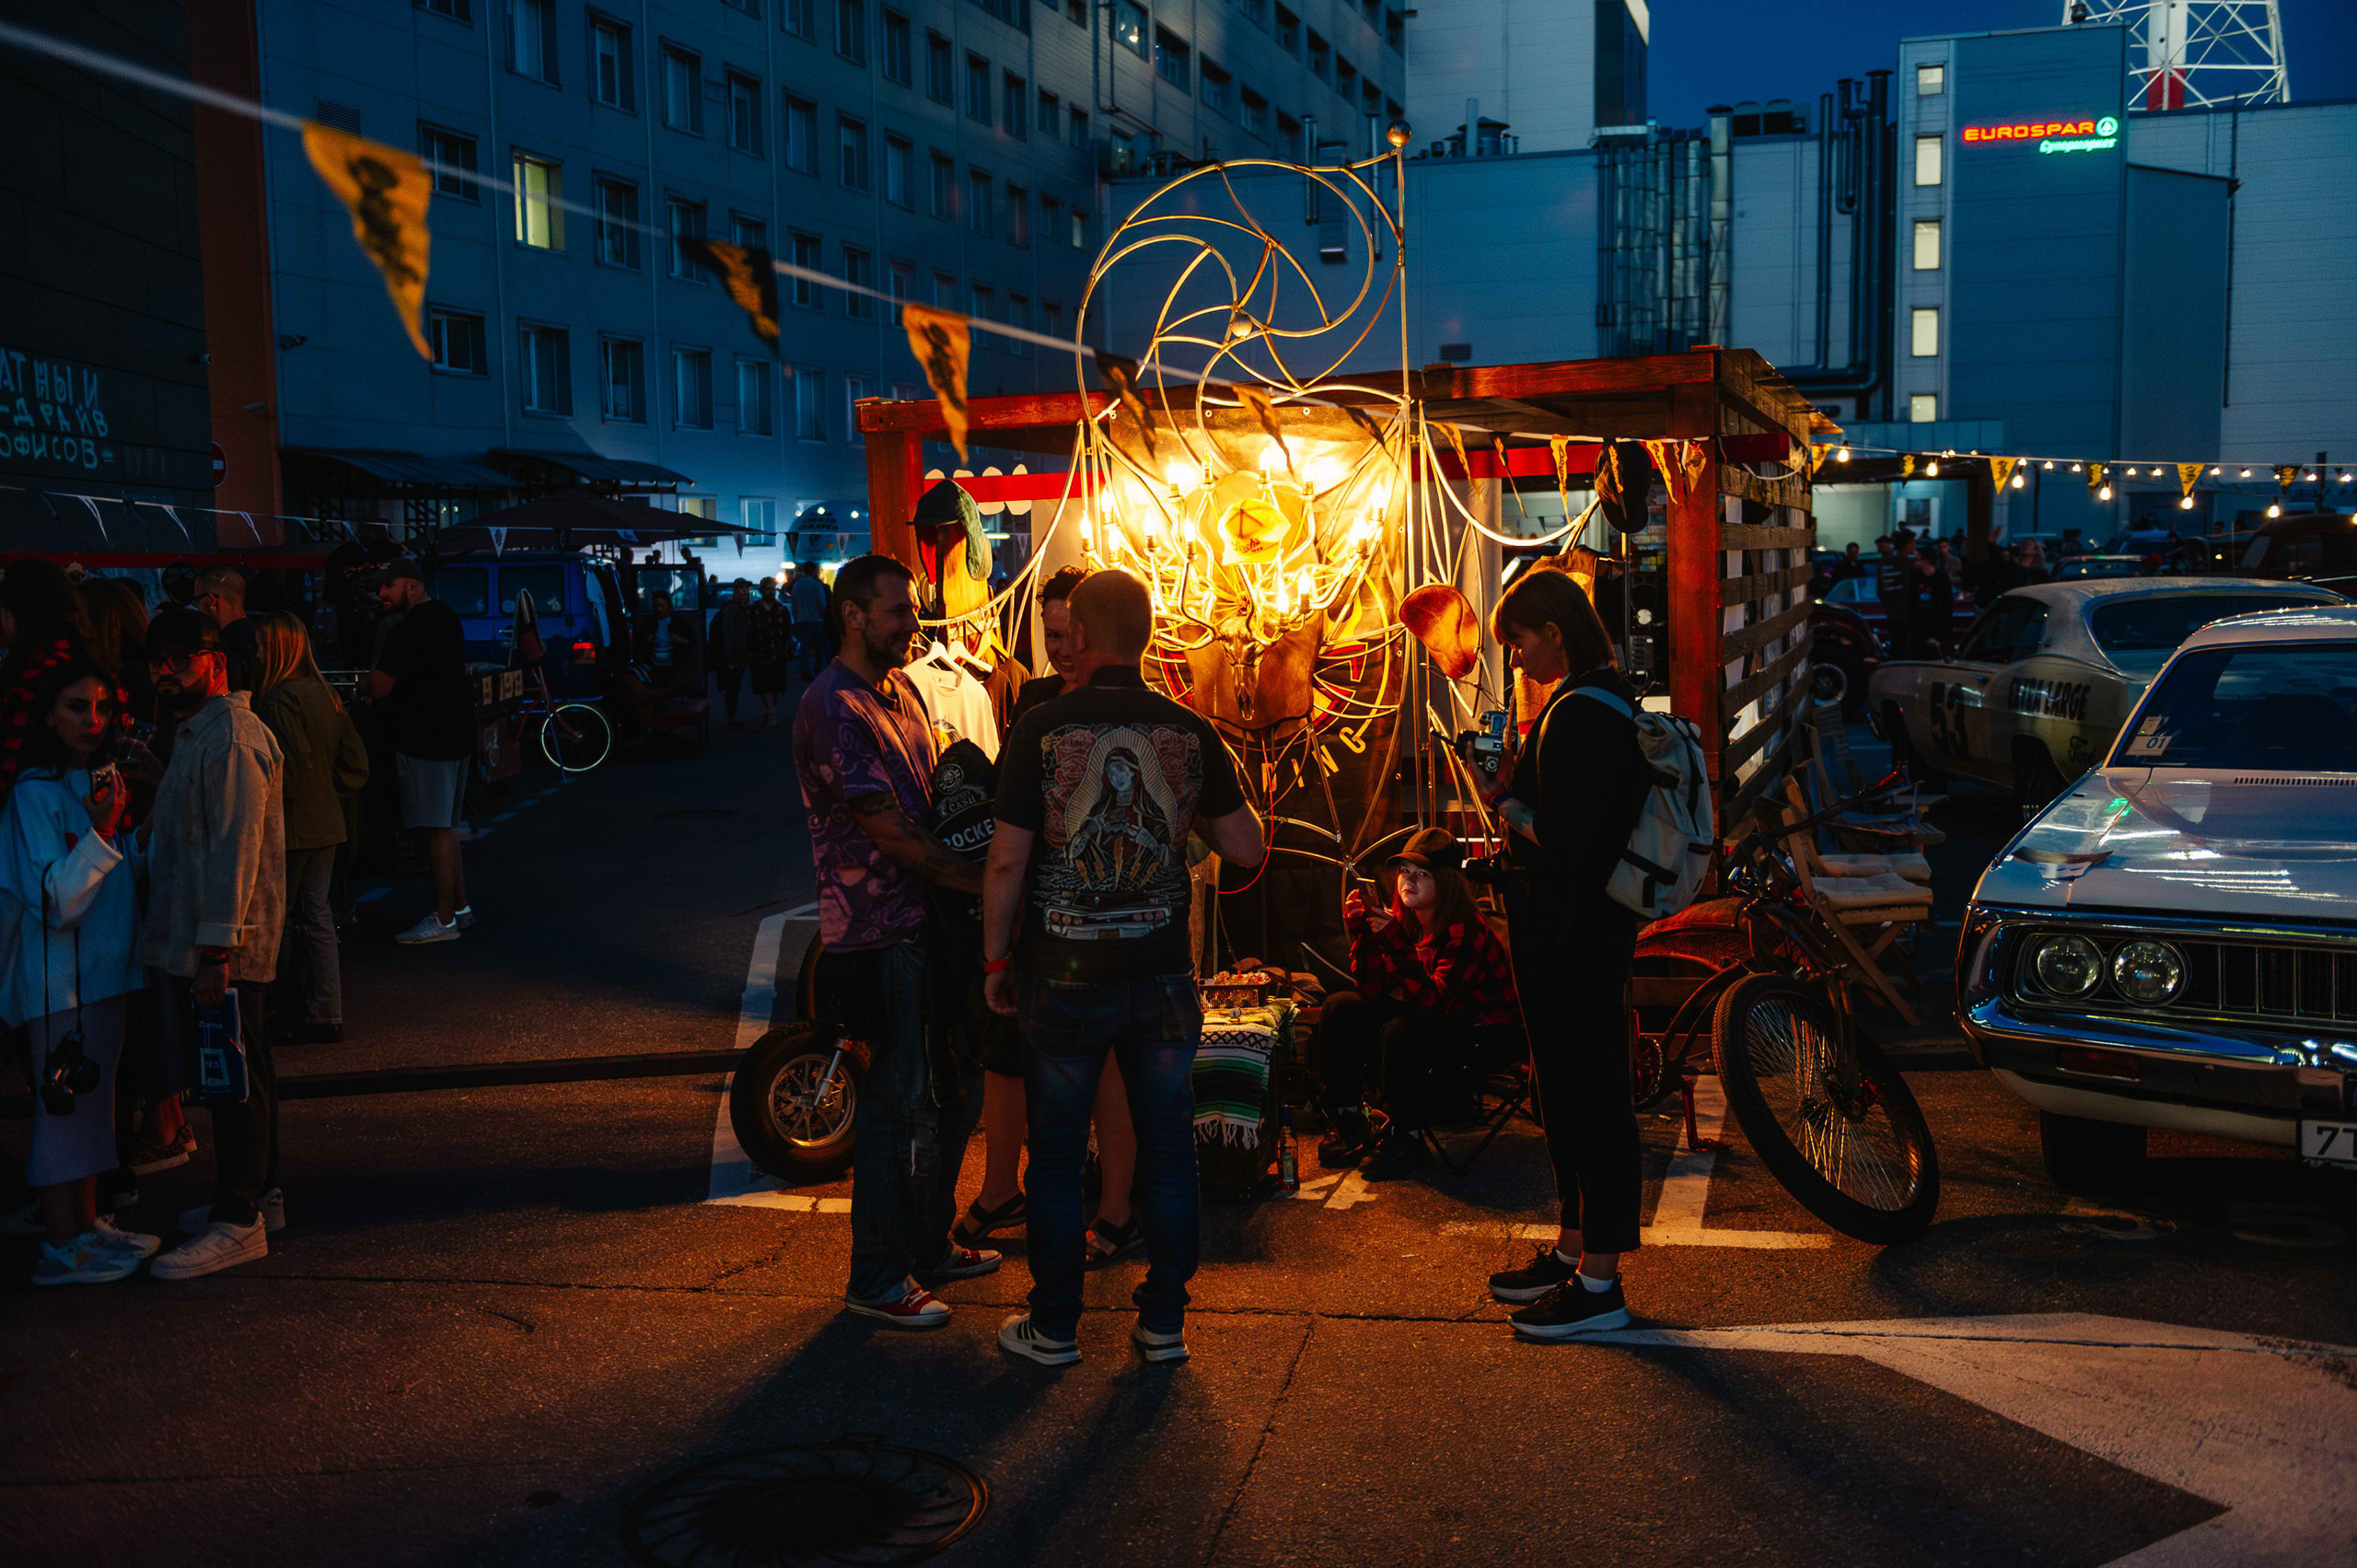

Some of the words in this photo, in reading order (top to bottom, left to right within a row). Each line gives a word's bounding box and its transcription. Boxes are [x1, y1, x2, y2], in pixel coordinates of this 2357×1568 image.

[1963, 121, 2095, 142] EUROSPAR
[2044, 680, 2092, 721] LARGE
[1931, 681, 1970, 760] 53
[2147, 737, 2166, 749] 01
[949, 795, 976, 813] CASH
[943, 817, 997, 848] OCKE
